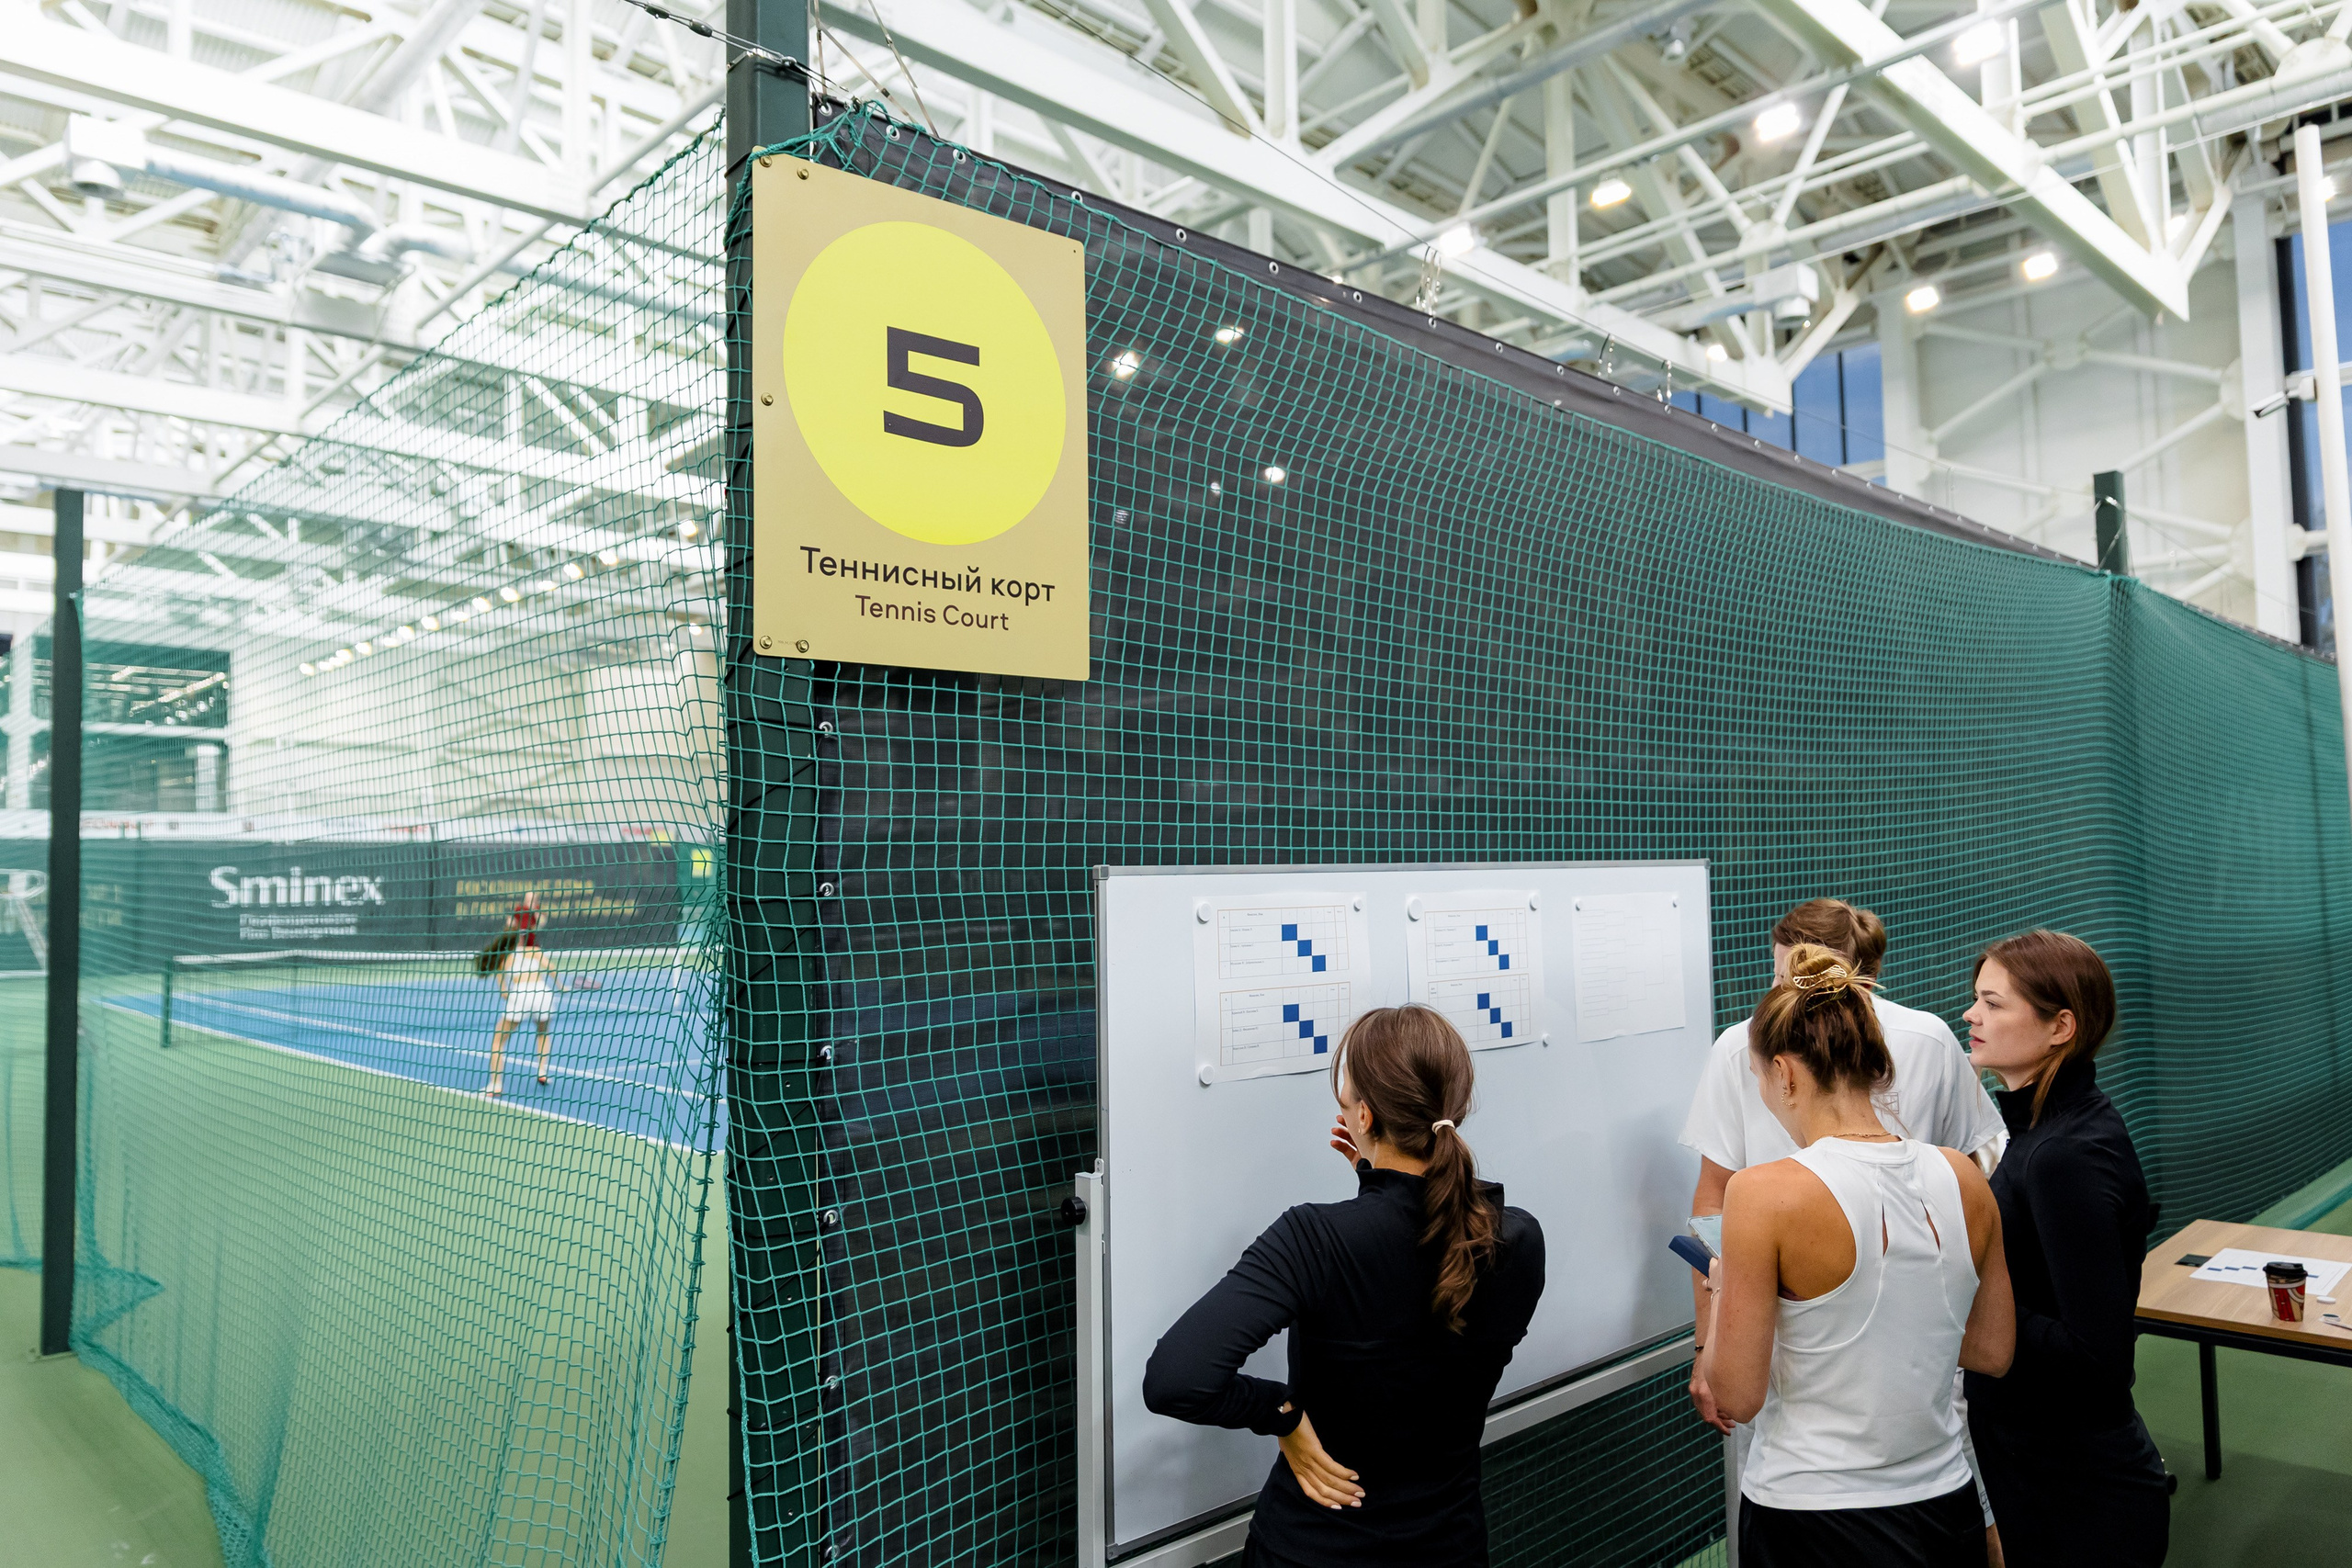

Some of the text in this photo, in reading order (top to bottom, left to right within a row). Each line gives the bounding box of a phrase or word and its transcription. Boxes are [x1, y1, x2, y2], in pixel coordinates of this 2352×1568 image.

[883, 325, 985, 448] 5
[799, 546, 1056, 607] Теннисный корт
[854, 594, 1010, 631] Tennis Court
[209, 865, 387, 908] Sminex
